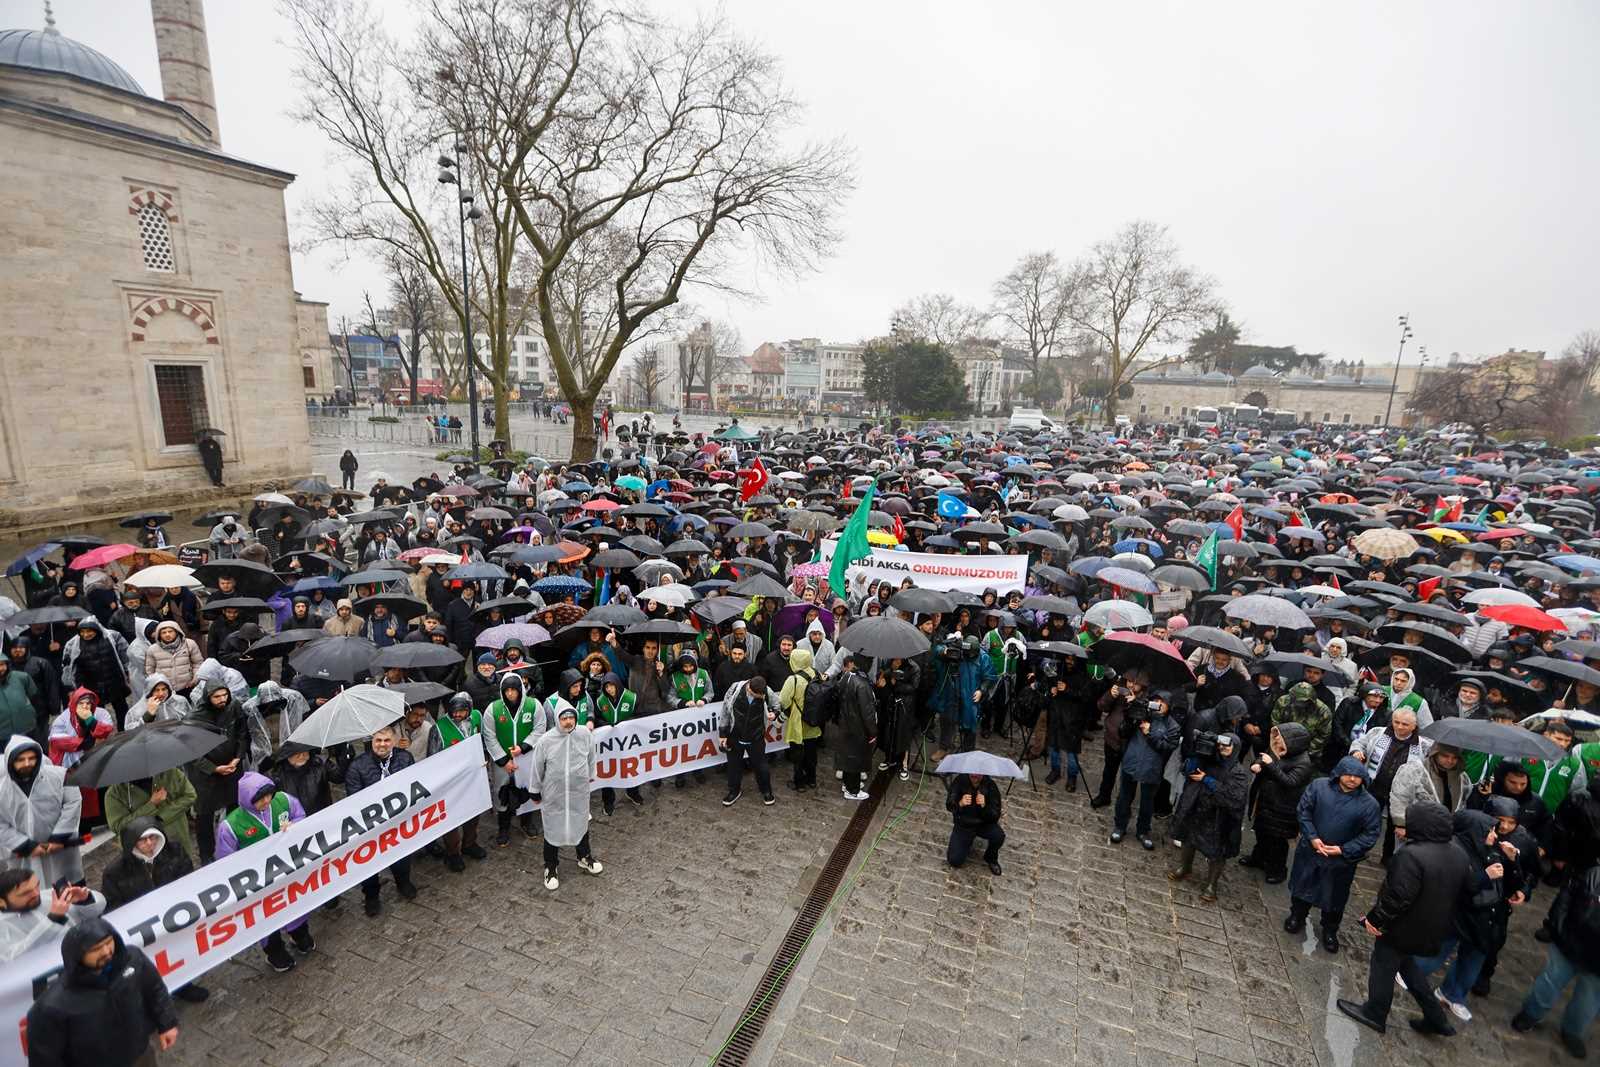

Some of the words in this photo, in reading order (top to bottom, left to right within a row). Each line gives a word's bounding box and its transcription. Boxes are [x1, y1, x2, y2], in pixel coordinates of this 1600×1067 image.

[876, 560, 910, 571] AKSA
[912, 564, 1018, 579] ONURUMUZDUR!
[649, 711, 721, 744] SİYONİ
[127, 780, 432, 948] TOPRAKLARDA
[195, 799, 447, 956] İSTEMİYORUZ!
